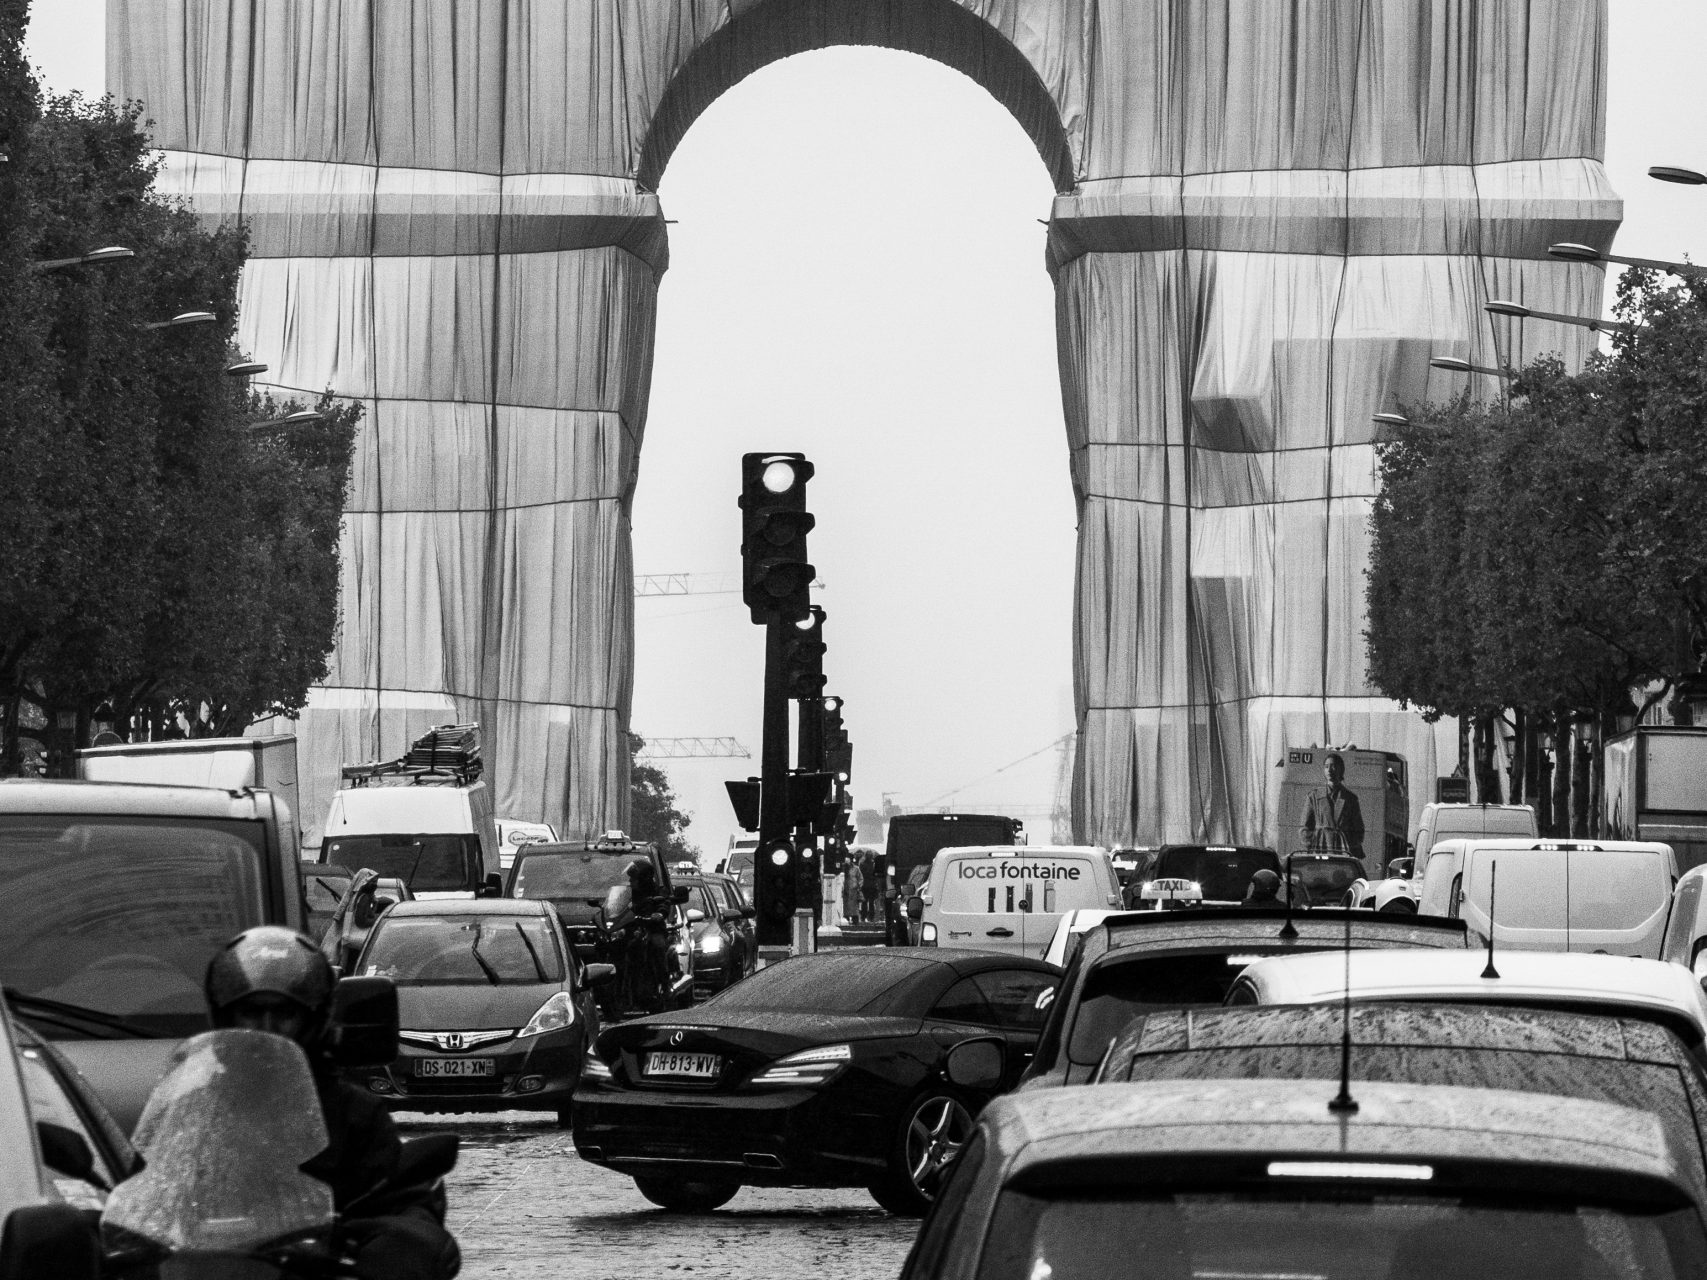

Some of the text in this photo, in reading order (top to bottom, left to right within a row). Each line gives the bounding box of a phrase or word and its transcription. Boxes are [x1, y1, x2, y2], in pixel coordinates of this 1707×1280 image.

[958, 861, 1081, 880] loca fontaine
[1157, 880, 1183, 891] TAXI
[424, 1061, 486, 1074] DS-021-XN
[652, 1055, 713, 1073] DH-813-WV
